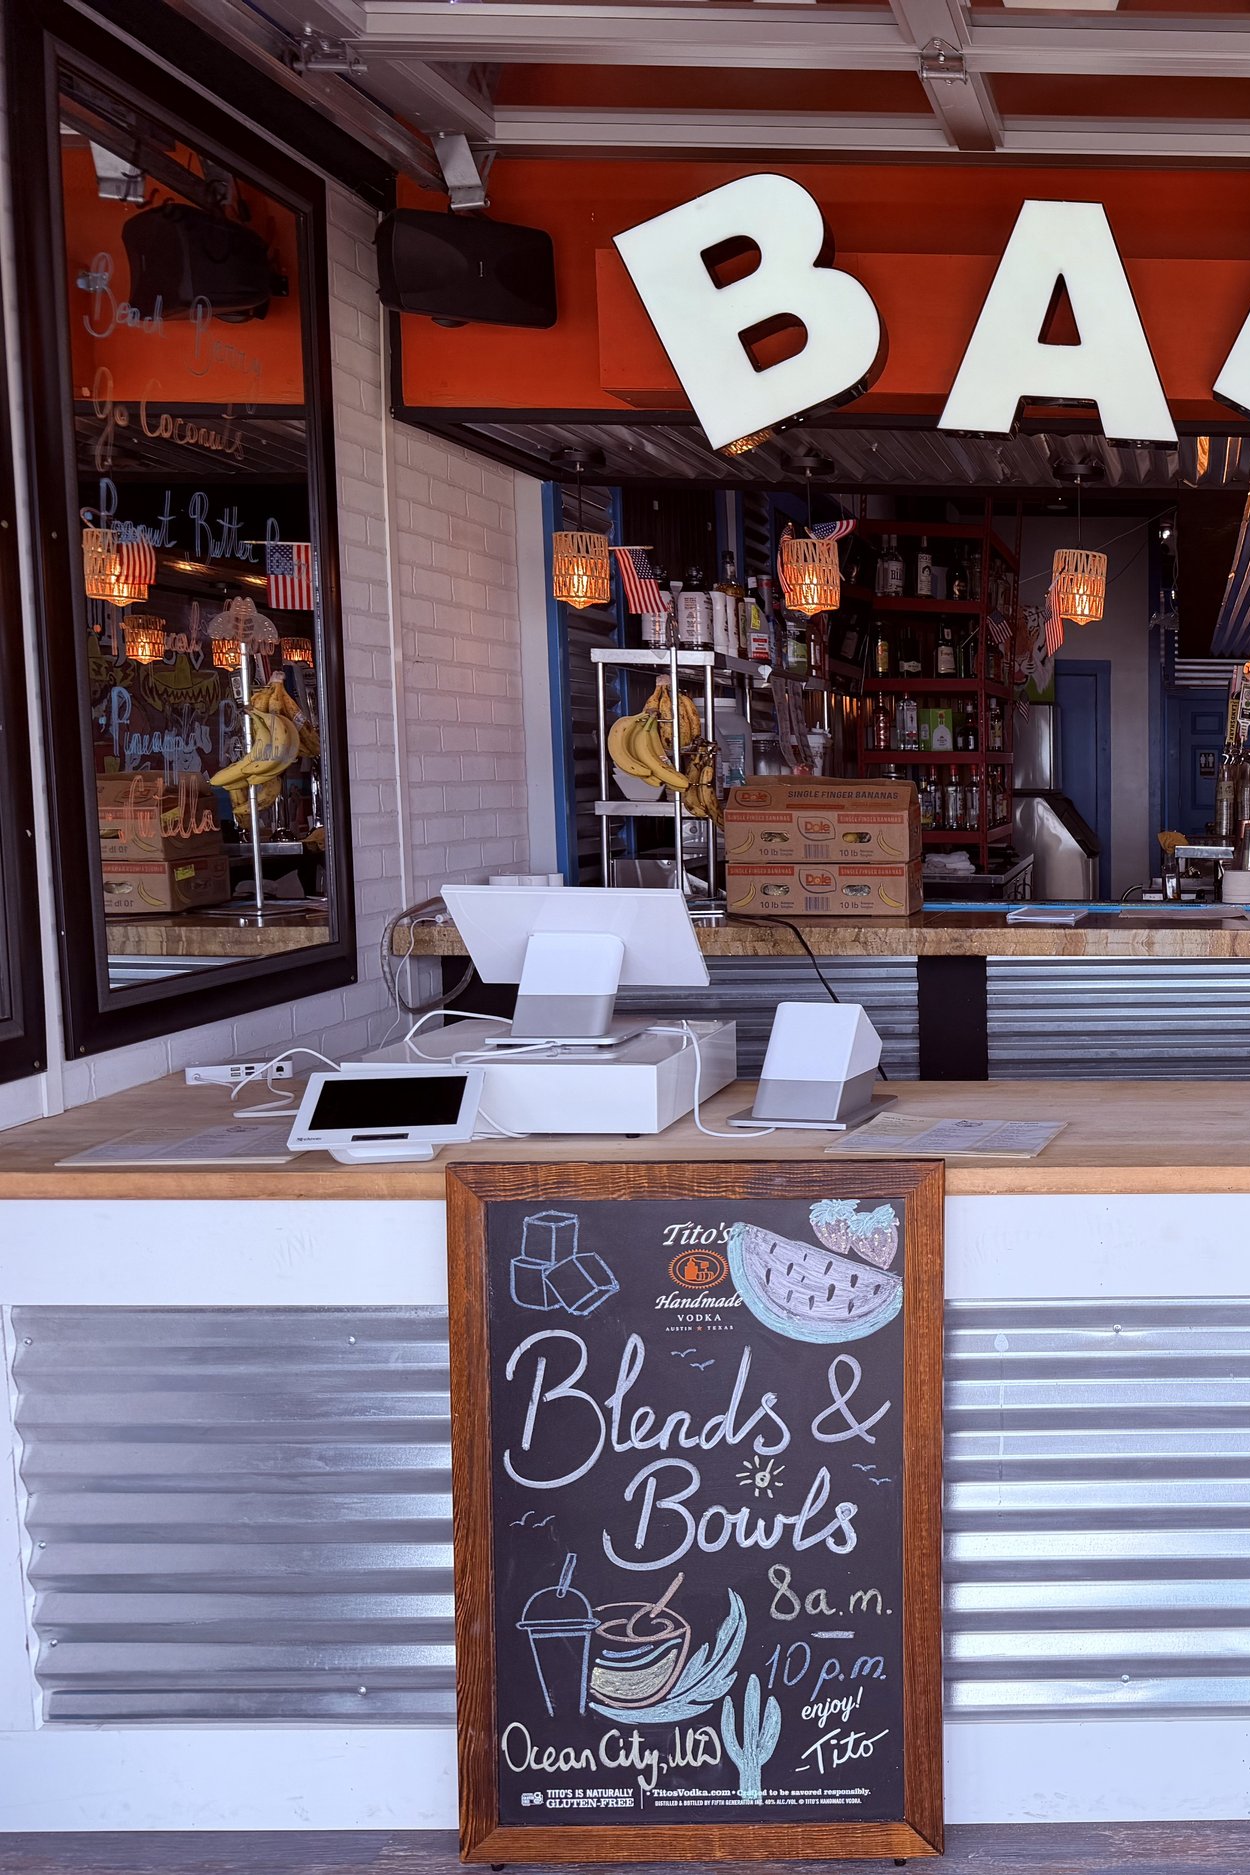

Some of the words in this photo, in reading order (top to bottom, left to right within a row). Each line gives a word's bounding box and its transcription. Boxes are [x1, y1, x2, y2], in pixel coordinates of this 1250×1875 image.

[140, 380, 244, 460] Coconuts
[187, 492, 259, 566] Butter
[741, 792, 768, 801] Dole
[788, 790, 819, 799] SINGLE
[821, 791, 855, 799] FINGER
[855, 791, 899, 800] BANANAS
[804, 821, 831, 832] Dole
[759, 848, 769, 856] 10
[770, 848, 779, 856] lb
[840, 849, 849, 857] 10
[850, 849, 858, 857] lb
[805, 874, 832, 885] Dole
[771, 901, 779, 909] lb
[850, 901, 859, 909] lb
[662, 1221, 734, 1246] Tito's
[655, 1291, 743, 1309] Handmade
[677, 1314, 722, 1322] VODKA
[504, 1329, 791, 1489] Blends
[811, 1353, 892, 1445] &
[602, 1457, 858, 1571] Bowls
[766, 1641, 812, 1689] 10
[810, 1653, 887, 1700] p.m.
[801, 1687, 863, 1727] enjoy!
[501, 1721, 597, 1773] Ocean
[546, 1789, 572, 1798] TITO'S
[575, 1789, 583, 1797] IS
[586, 1788, 634, 1797] NATURALLY
[652, 1788, 731, 1797] TitosVodka.com
[769, 1788, 778, 1796] to
[780, 1788, 789, 1796] be
[791, 1788, 822, 1796] savored
[824, 1787, 871, 1797] responsibly.
[546, 1798, 634, 1808] GLUTEN-FREE
